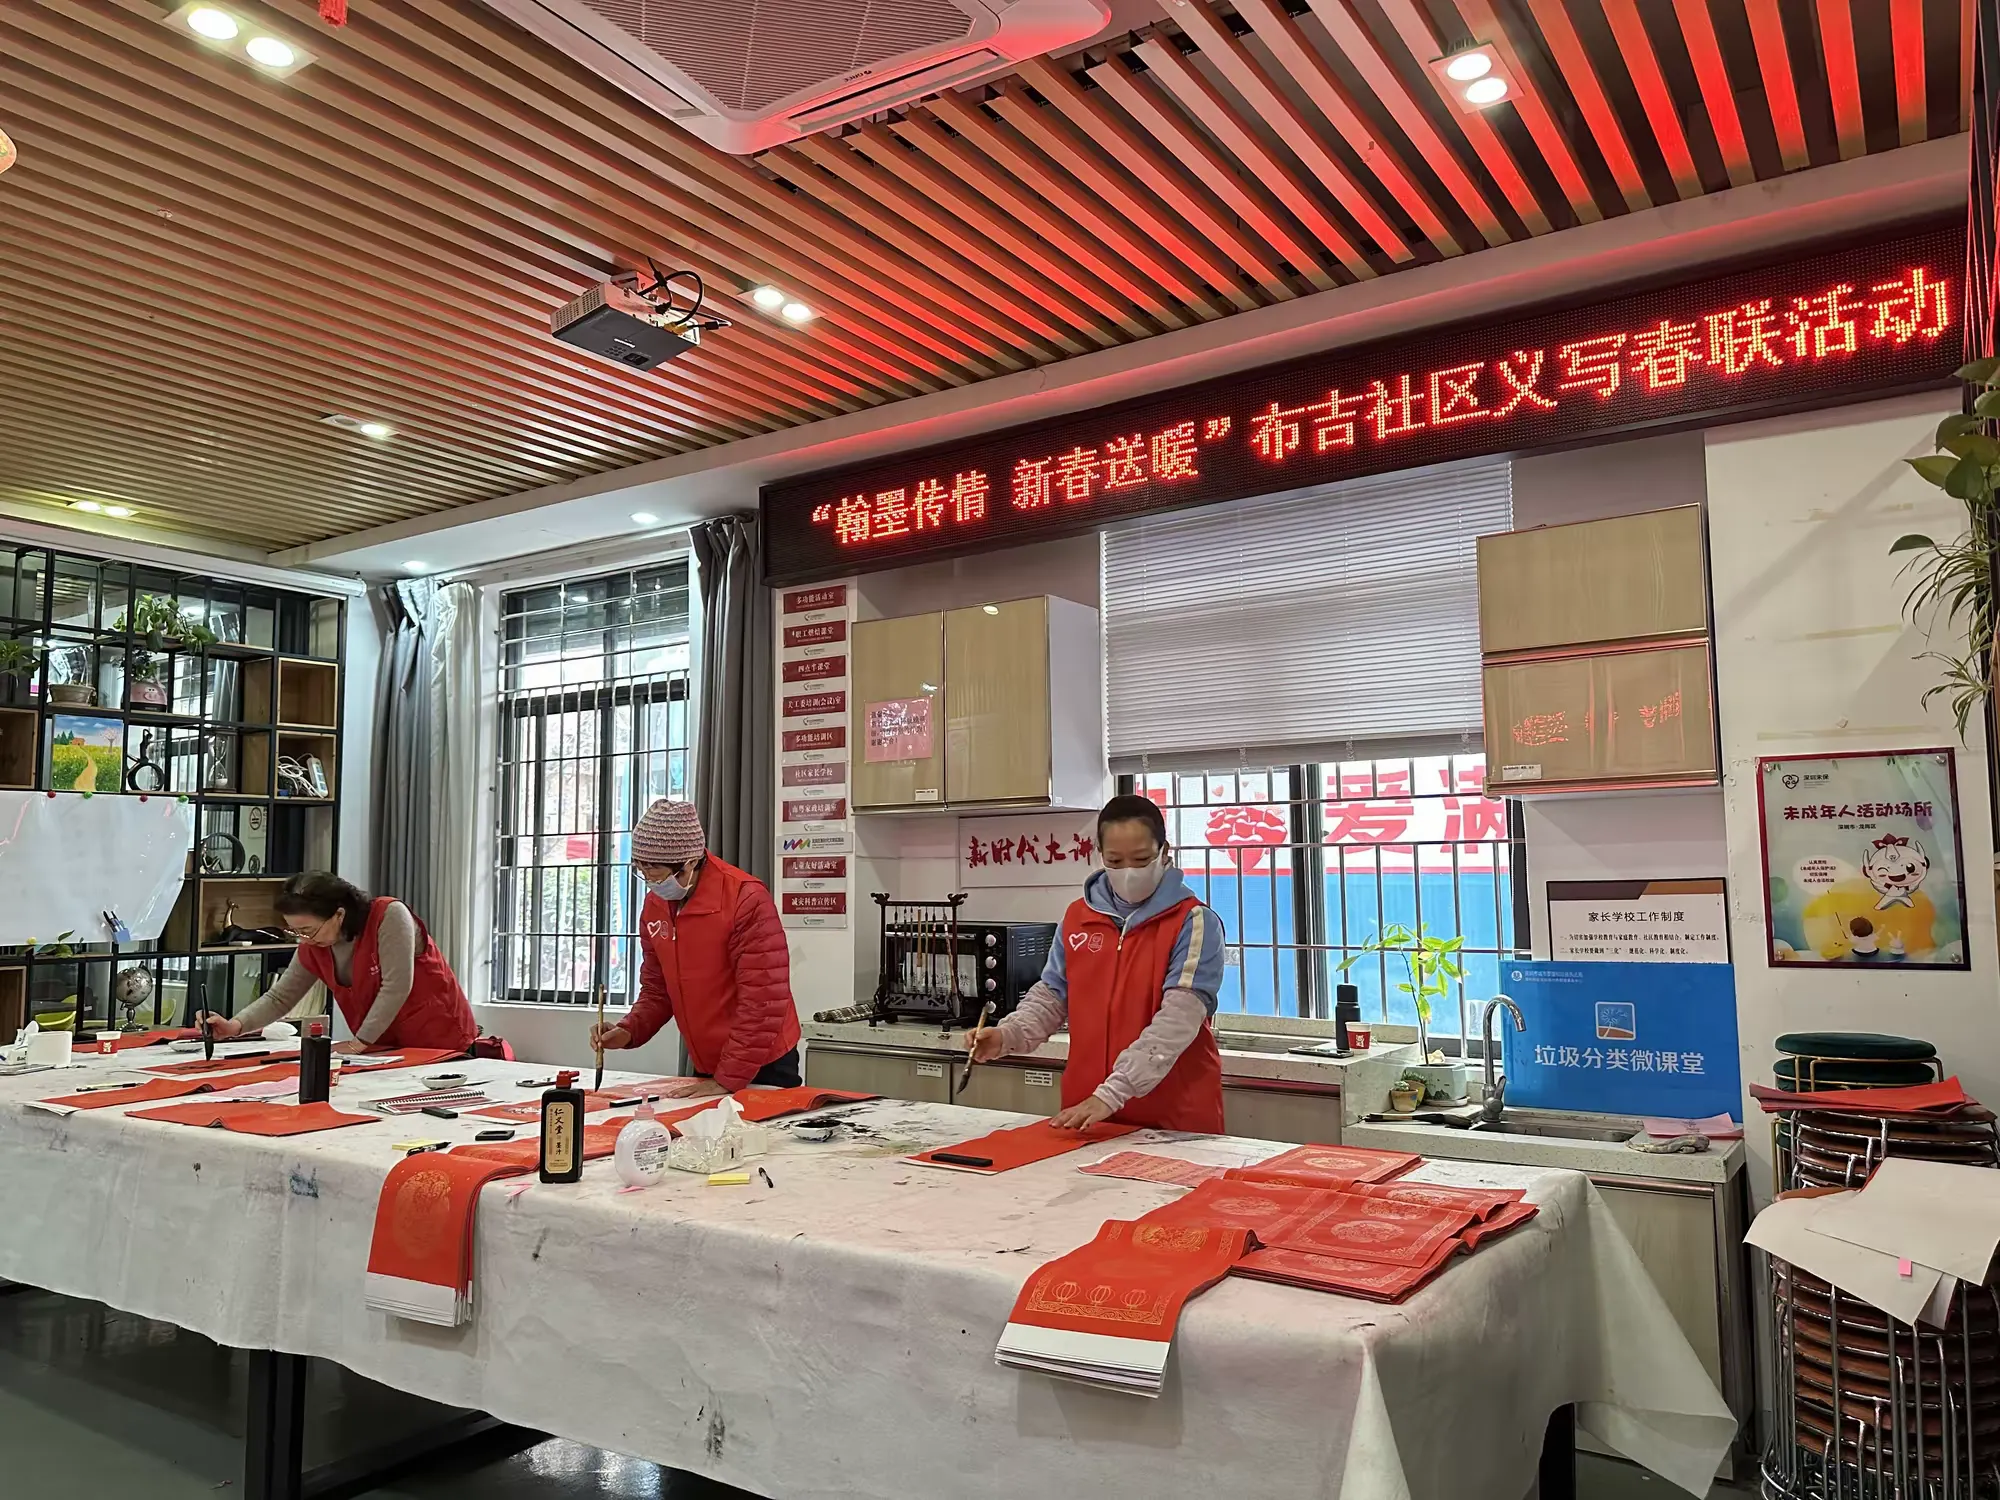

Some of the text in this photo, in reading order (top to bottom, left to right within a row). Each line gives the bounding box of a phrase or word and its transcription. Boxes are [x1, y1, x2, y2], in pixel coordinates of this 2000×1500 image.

[812, 268, 1949, 544] “翰墨传情 新春送暖” 布吉社区义写春联活动
[798, 662, 830, 673] 四点半课堂
[796, 732, 833, 743] 多功能培训区
[795, 768, 833, 779] 社区家长学校
[1783, 801, 1933, 821] 未成年人活动场所
[1588, 911, 1685, 922] 家长学校工作制度
[1534, 1044, 1706, 1075] 垃圾分类微课堂
